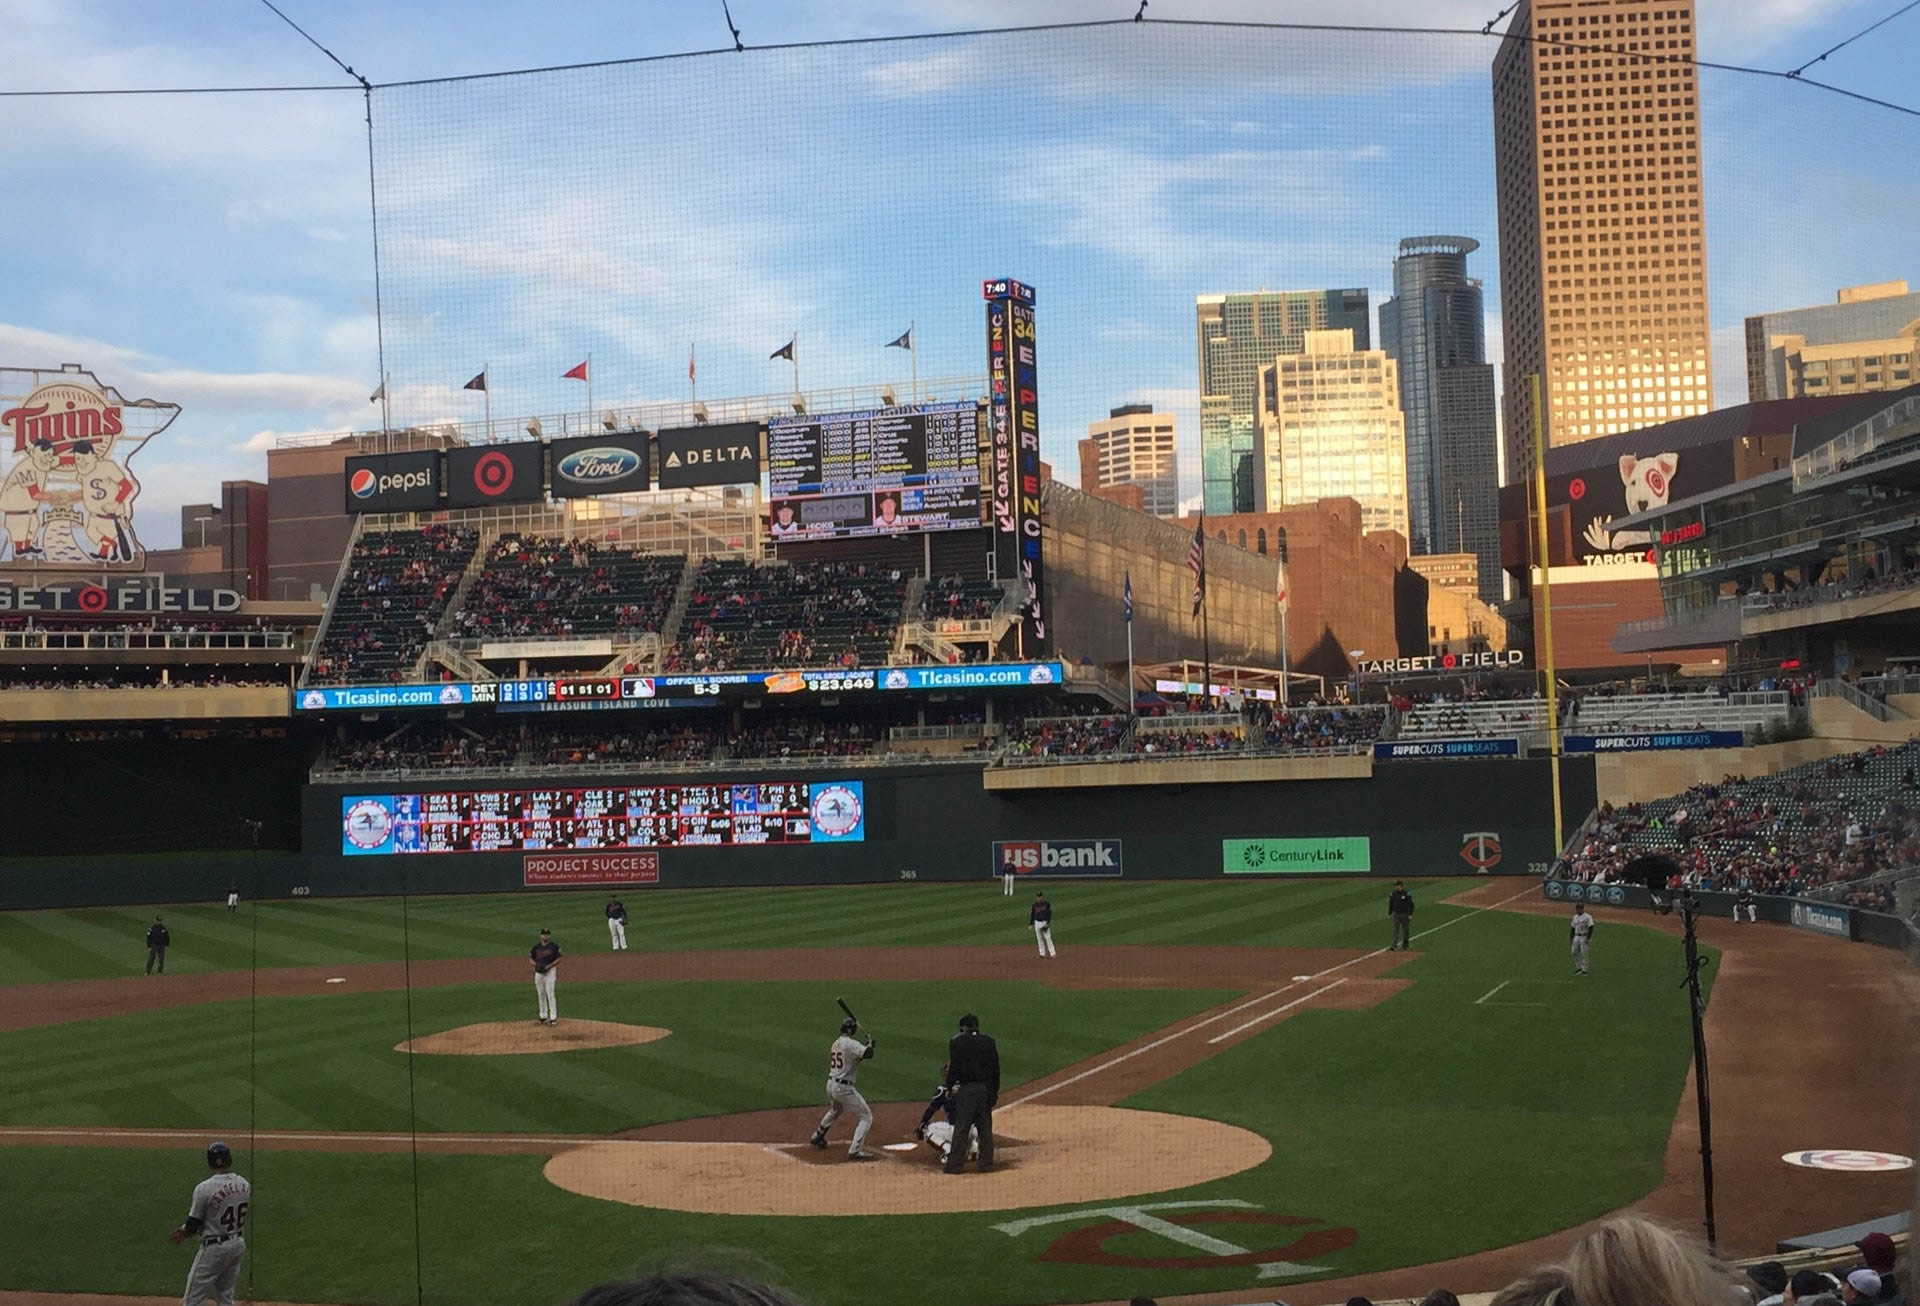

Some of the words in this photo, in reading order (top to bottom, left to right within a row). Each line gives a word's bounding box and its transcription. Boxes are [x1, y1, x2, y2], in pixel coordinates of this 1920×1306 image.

[986, 282, 1006, 294] 7:40
[1014, 305, 1035, 322] GATE
[1014, 318, 1035, 342] 34
[2, 401, 123, 452] Twins
[996, 420, 1008, 444] 34
[687, 446, 752, 465] DELTA
[1019, 344, 1041, 560] EXPERIENCE
[574, 454, 622, 478] Ford
[996, 448, 1009, 498] GATE
[379, 468, 431, 494] pepsi
[902, 513, 948, 522] STEWART
[1583, 552, 1646, 566] TARGET
[118, 588, 242, 611] FIELD
[1358, 656, 1436, 673] TARGET
[1462, 650, 1523, 666] FIELD
[666, 677, 706, 685] OFFICIAL
[809, 679, 874, 691] $23,649
[472, 684, 496, 693] DET
[537, 683, 542, 691] 1
[694, 684, 720, 695] 5-3
[472, 693, 496, 702] MIN
[504, 692, 512, 701] 2
[519, 692, 527, 700] 3
[534, 691, 542, 699] 0
[541, 702, 592, 711] TREASURE
[600, 700, 637, 709] ISLAND
[644, 698, 671, 707] COVE
[1595, 737, 1650, 748] SUPERCUTS
[1653, 735, 1710, 746] SUPERSEATS
[1392, 744, 1444, 755] SUPERCUTS
[1446, 742, 1500, 753] SUPERSEATS
[690, 788, 707, 796] TEX
[712, 787, 717, 795] 1
[769, 785, 784, 794] PHI
[789, 785, 796, 793] 4
[503, 793, 509, 801] 7
[533, 792, 551, 800] LAA
[555, 791, 560, 800] 7
[607, 791, 613, 799] 2
[789, 794, 796, 803] 0
[585, 800, 603, 808] OAK
[659, 798, 665, 806] 4
[689, 796, 709, 805] HOU
[712, 796, 718, 804] 0
[503, 802, 509, 811] 2
[432, 824, 446, 832] PIT
[452, 824, 458, 832] 2
[482, 823, 499, 831] MIL
[504, 822, 508, 831] 1
[534, 821, 551, 829] MIA
[586, 820, 603, 828] ATL
[608, 819, 612, 827] 1
[587, 828, 603, 837] ARI
[607, 828, 614, 836] 0
[743, 825, 761, 833] LAD
[431, 834, 447, 842] STL
[452, 833, 457, 841] 1
[482, 831, 500, 840] CHC
[504, 831, 509, 839] 2
[532, 830, 552, 839] NYM
[556, 830, 560, 838] 1
[1270, 849, 1344, 862] CenturyLink
[528, 859, 588, 872] PROJECT
[592, 858, 655, 870] SUCCESS
[1528, 863, 1548, 872] 328
[292, 887, 310, 895] 403
